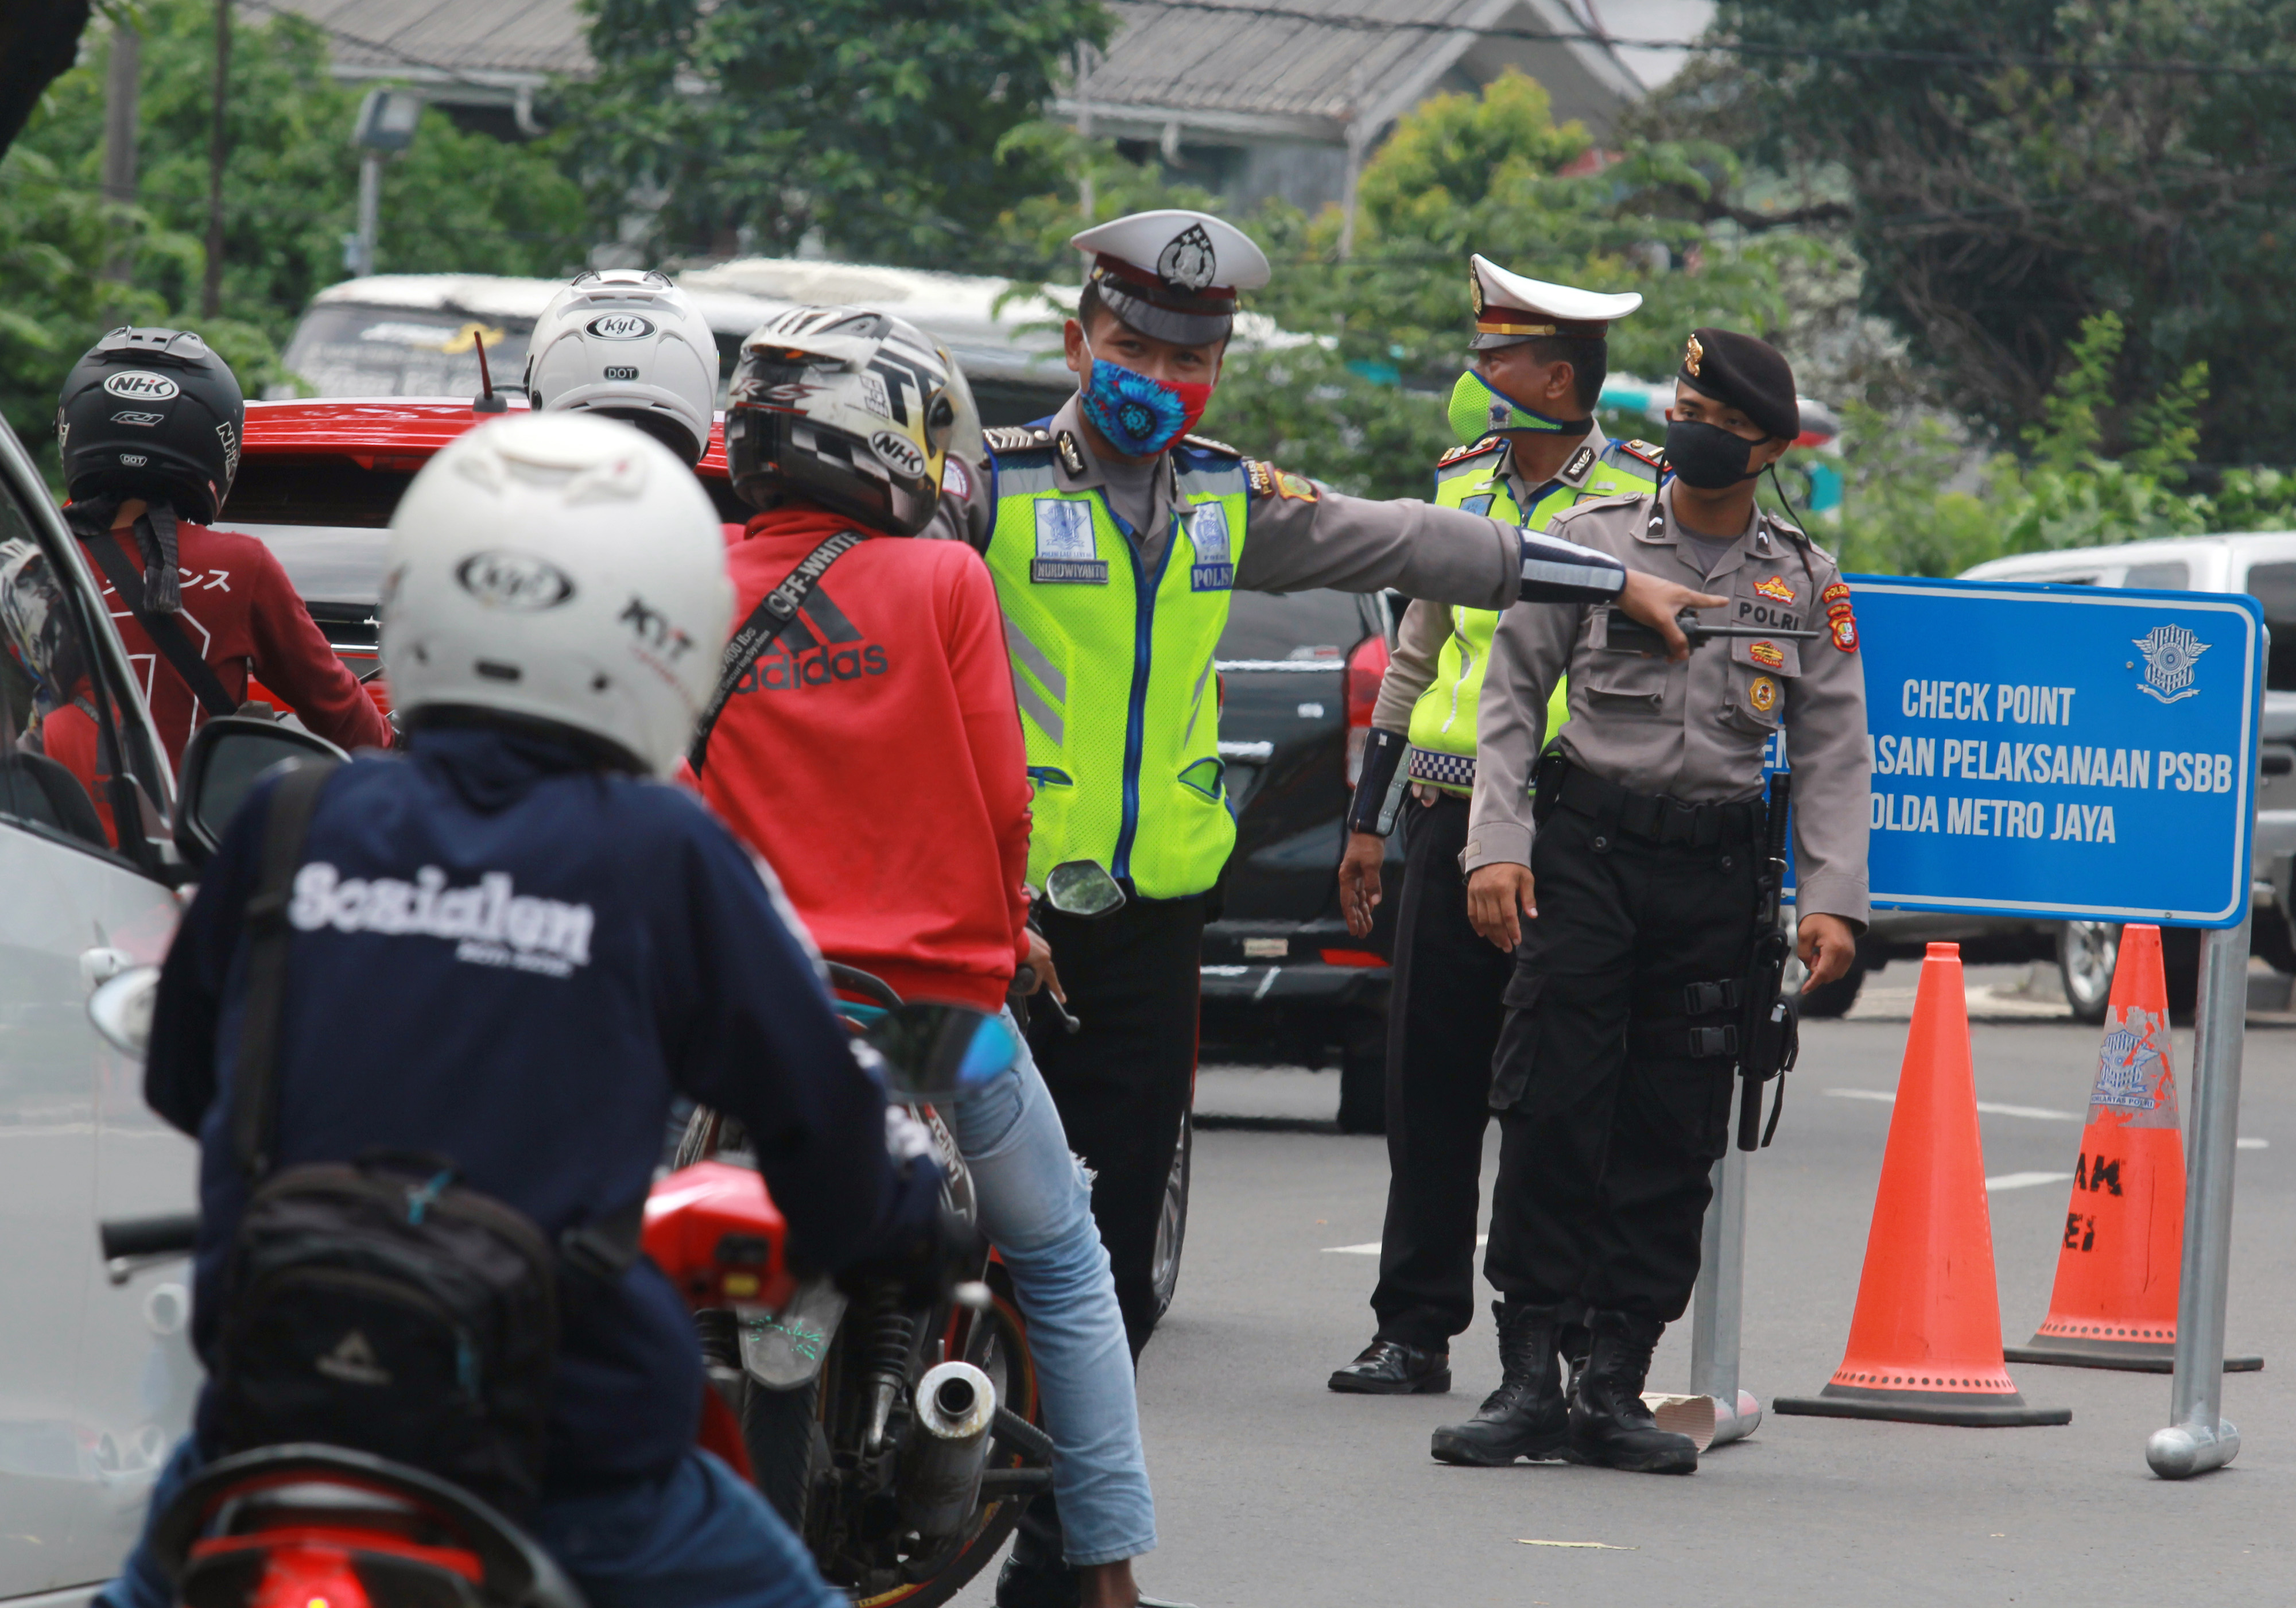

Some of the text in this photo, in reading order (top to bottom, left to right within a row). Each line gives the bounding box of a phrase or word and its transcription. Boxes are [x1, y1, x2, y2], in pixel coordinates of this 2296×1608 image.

[112, 377, 170, 395] NHK
[607, 368, 635, 378] DOT
[123, 456, 145, 464] DOT
[215, 421, 241, 481] NHK
[875, 435, 923, 472] NHK
[1739, 602, 1799, 631] POLRI
[733, 644, 889, 695] adidas
[1902, 678, 2076, 726] CHECK POINT
[1943, 738, 2151, 790] PELAKSANAAN
[2158, 751, 2232, 794] PSBB
[1946, 799, 2045, 839] METRO
[2050, 803, 2116, 844] JAYA
